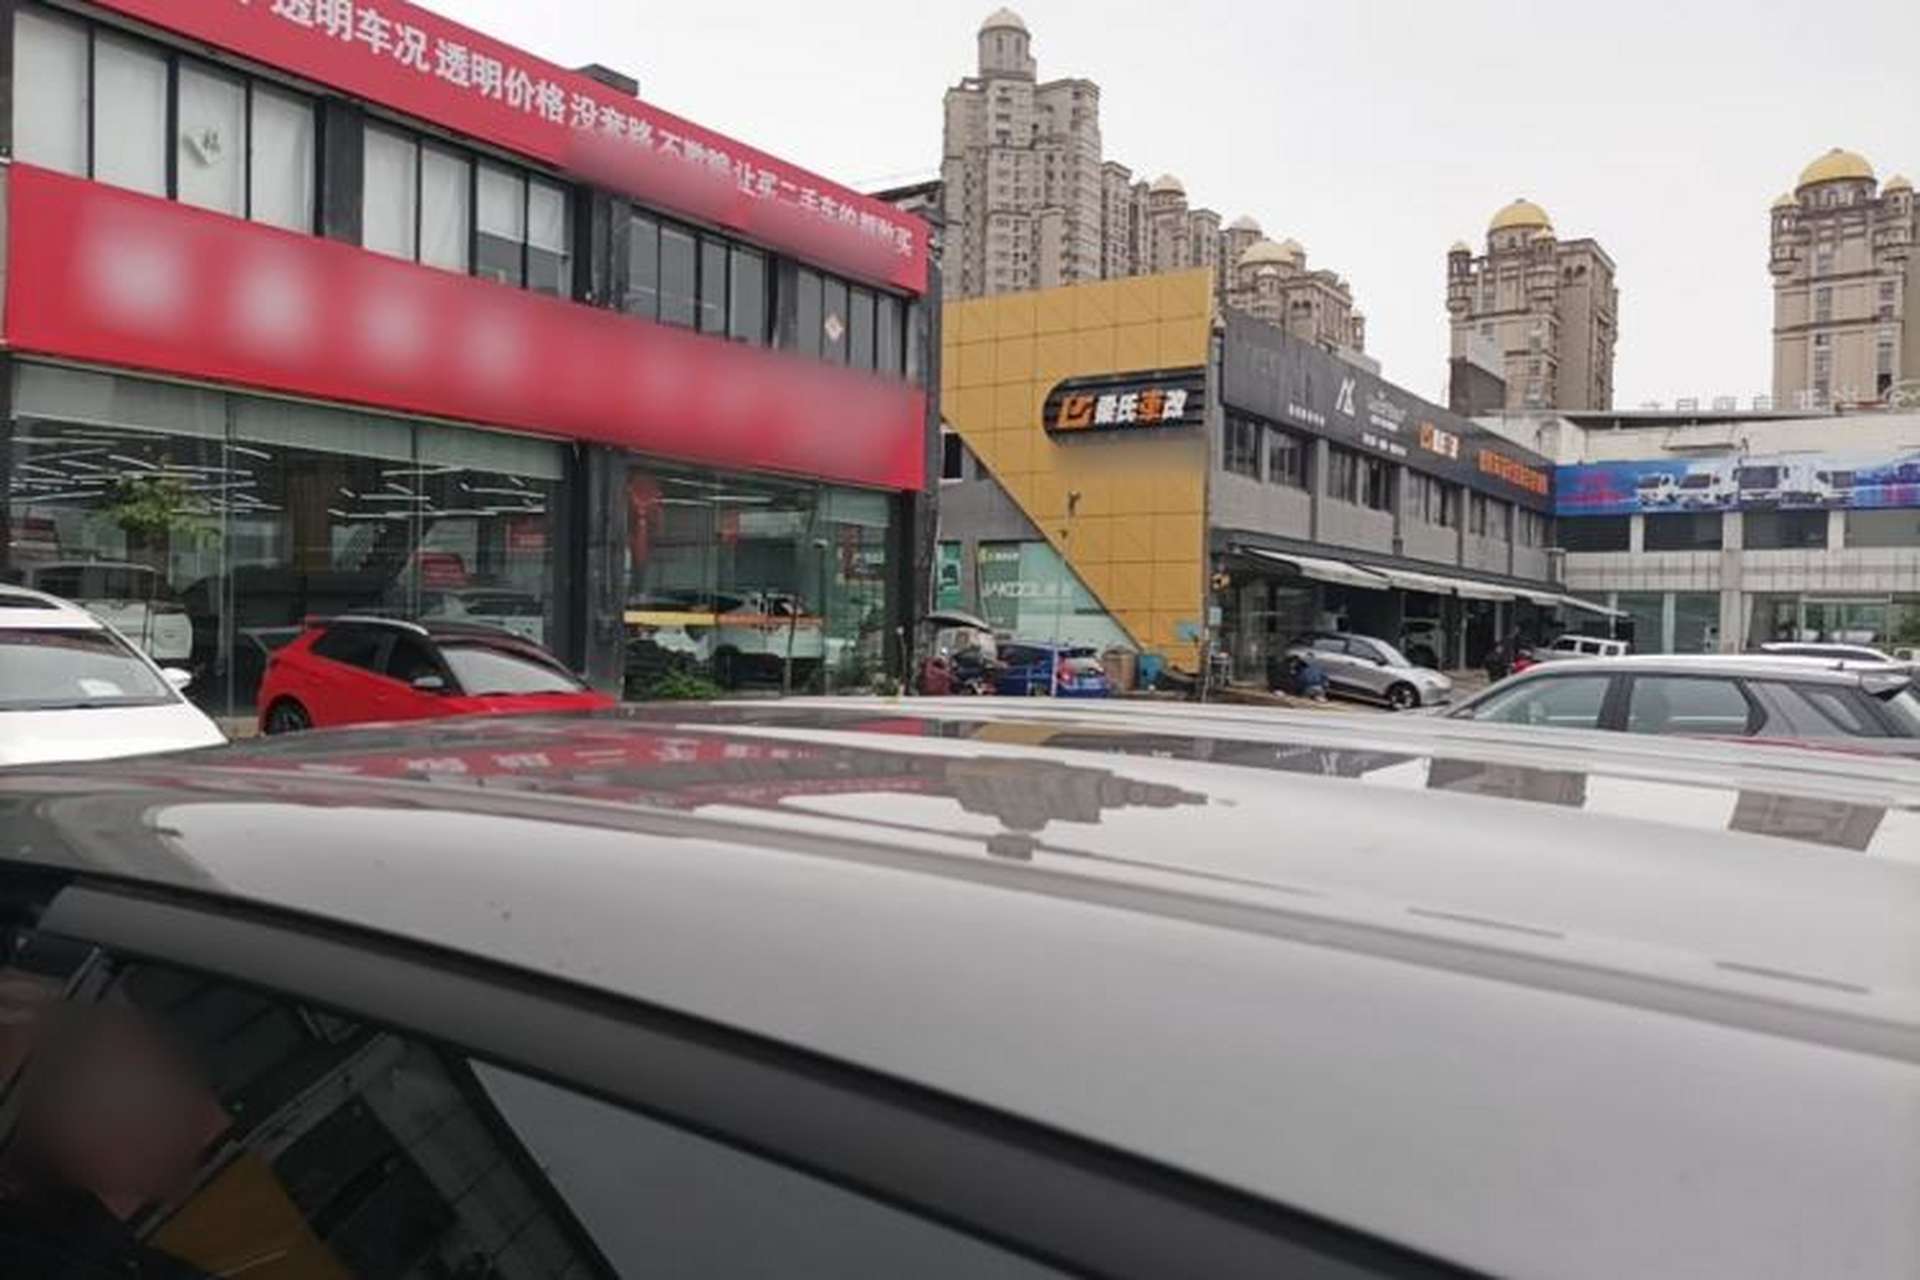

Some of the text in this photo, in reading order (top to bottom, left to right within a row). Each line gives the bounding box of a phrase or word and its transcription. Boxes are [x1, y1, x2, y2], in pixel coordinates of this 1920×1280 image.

[271, 0, 432, 73] 透明车况
[435, 38, 567, 123] 透明价格
